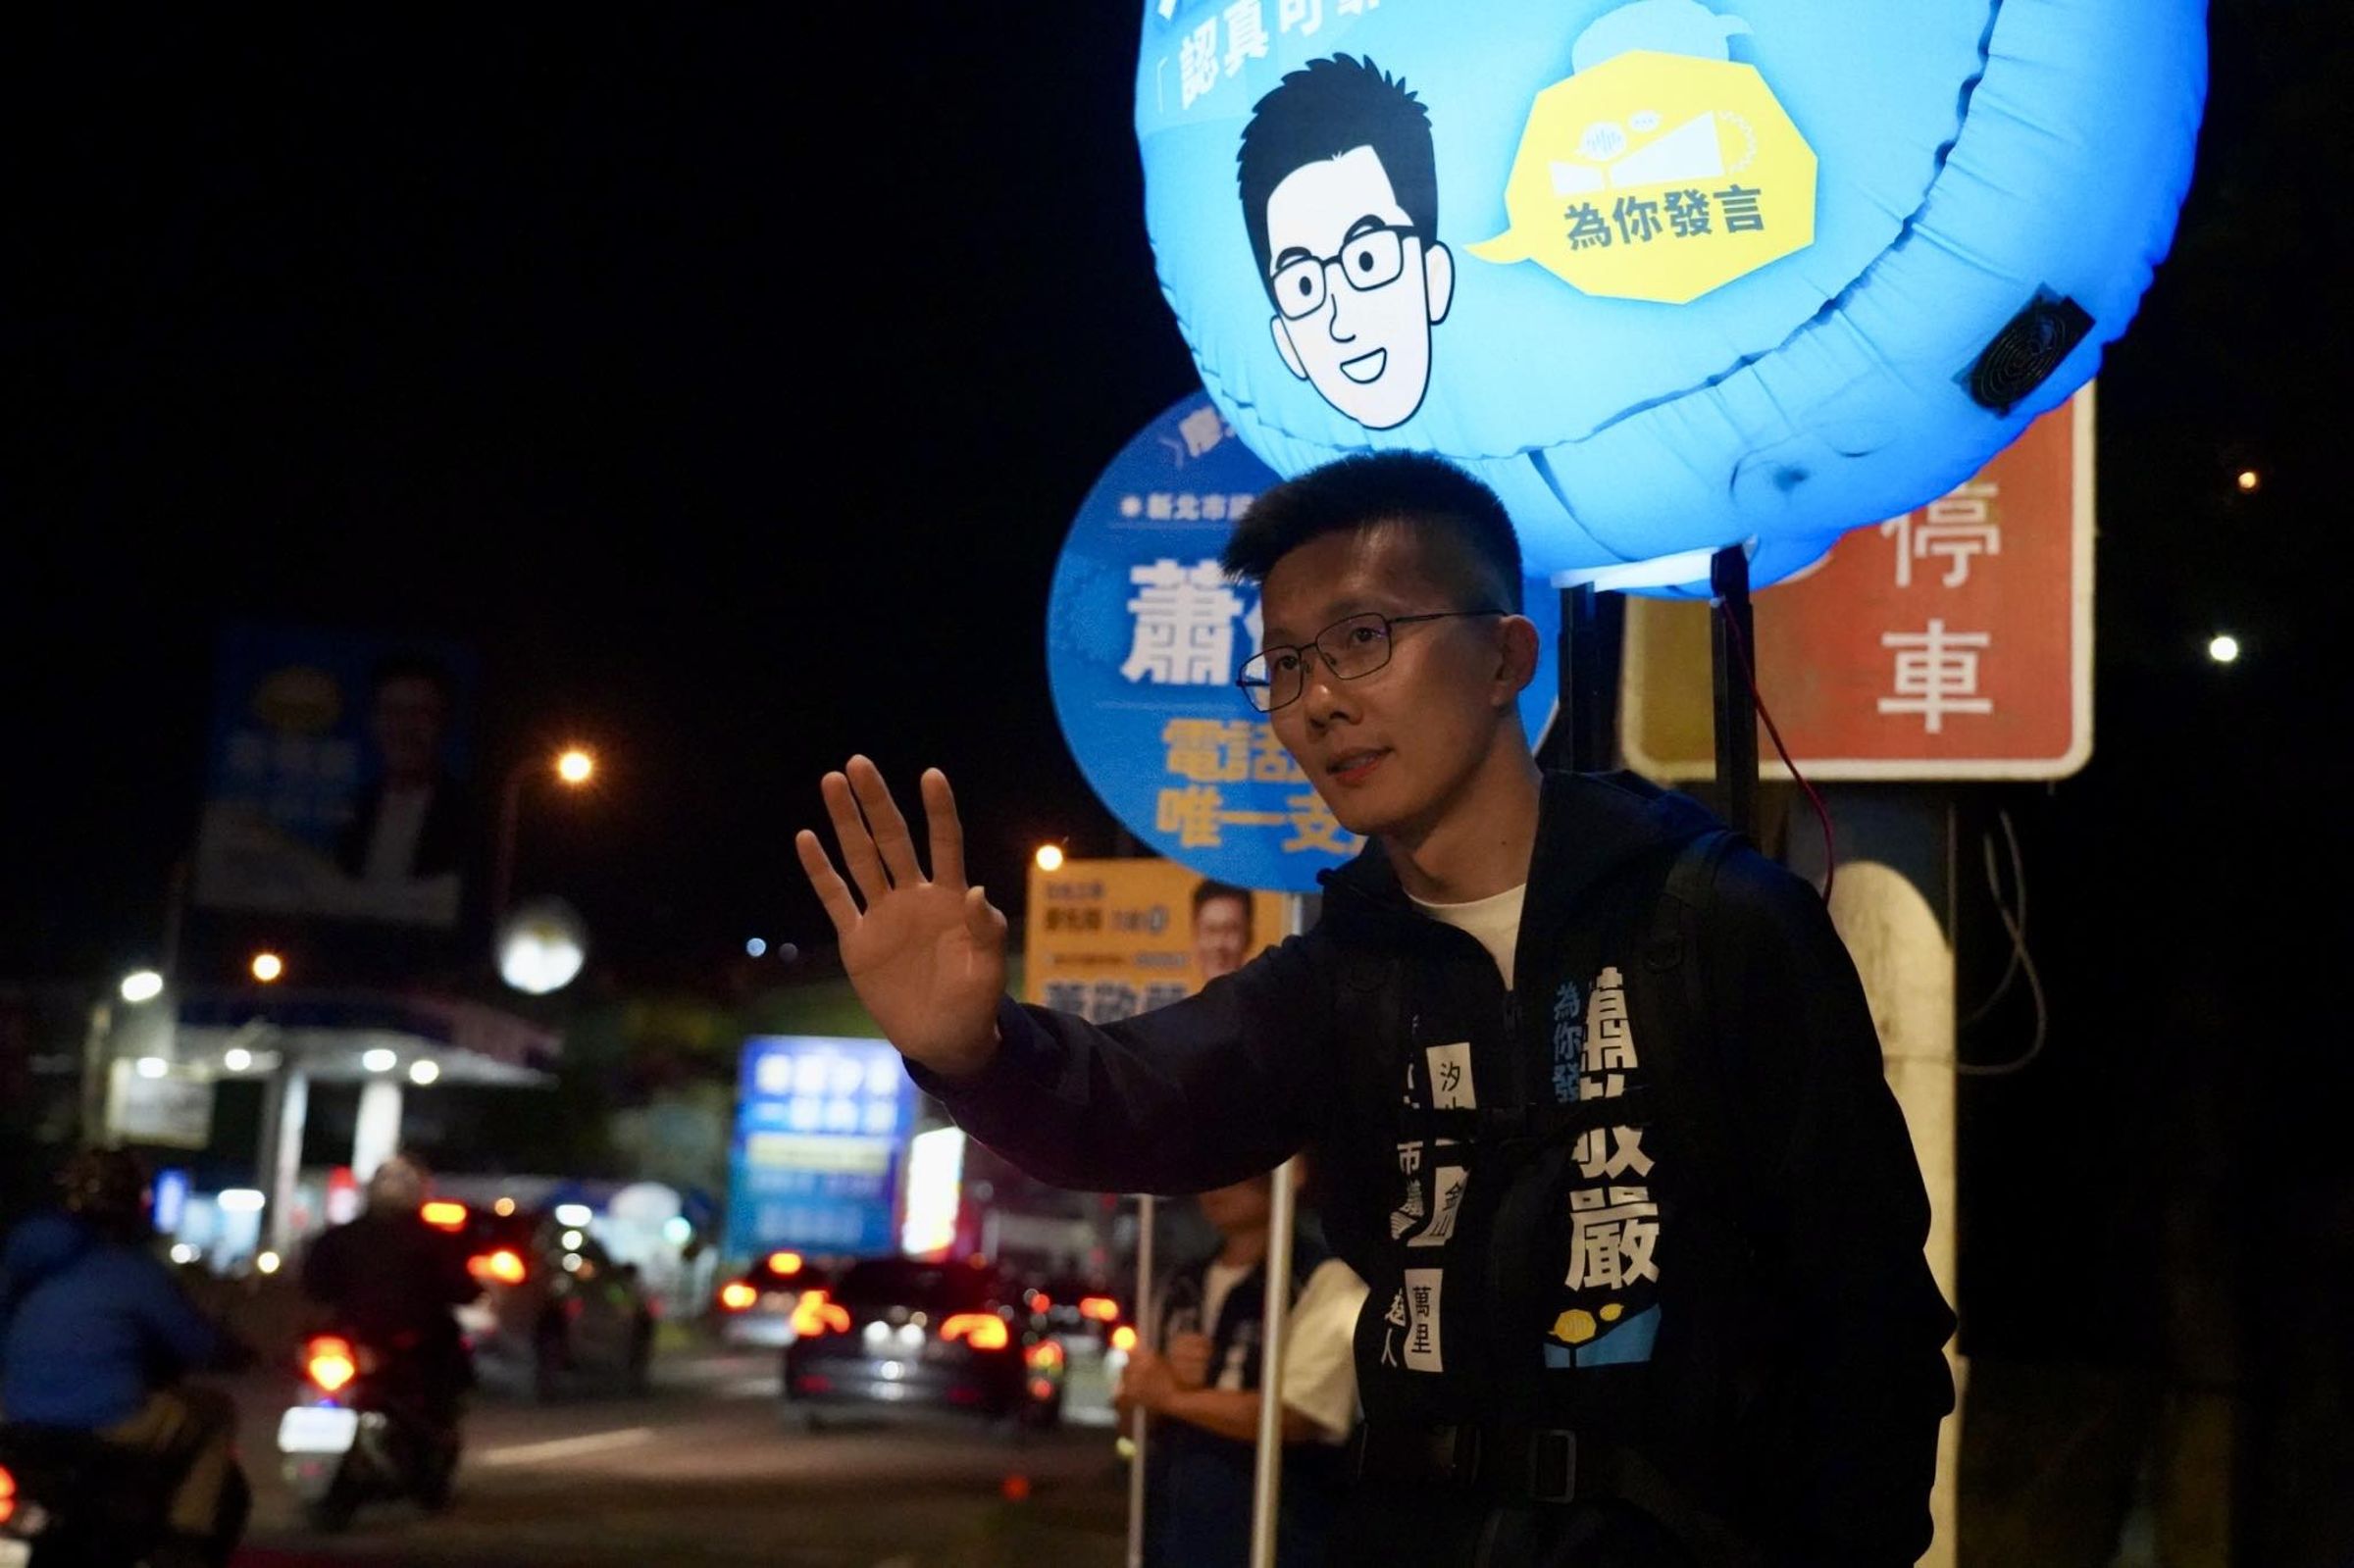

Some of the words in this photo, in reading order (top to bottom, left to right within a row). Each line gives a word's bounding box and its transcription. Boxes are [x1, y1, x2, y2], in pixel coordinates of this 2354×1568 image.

[1180, 0, 1380, 110] 認真可
[1563, 183, 1765, 251] 為你發言
[1120, 559, 1269, 685] 蕭
[1877, 483, 2000, 734] 停車
[1161, 718, 1311, 782] 電話
[1155, 784, 1369, 854] 唯一支
[1410, 1286, 1433, 1353] 萬里
